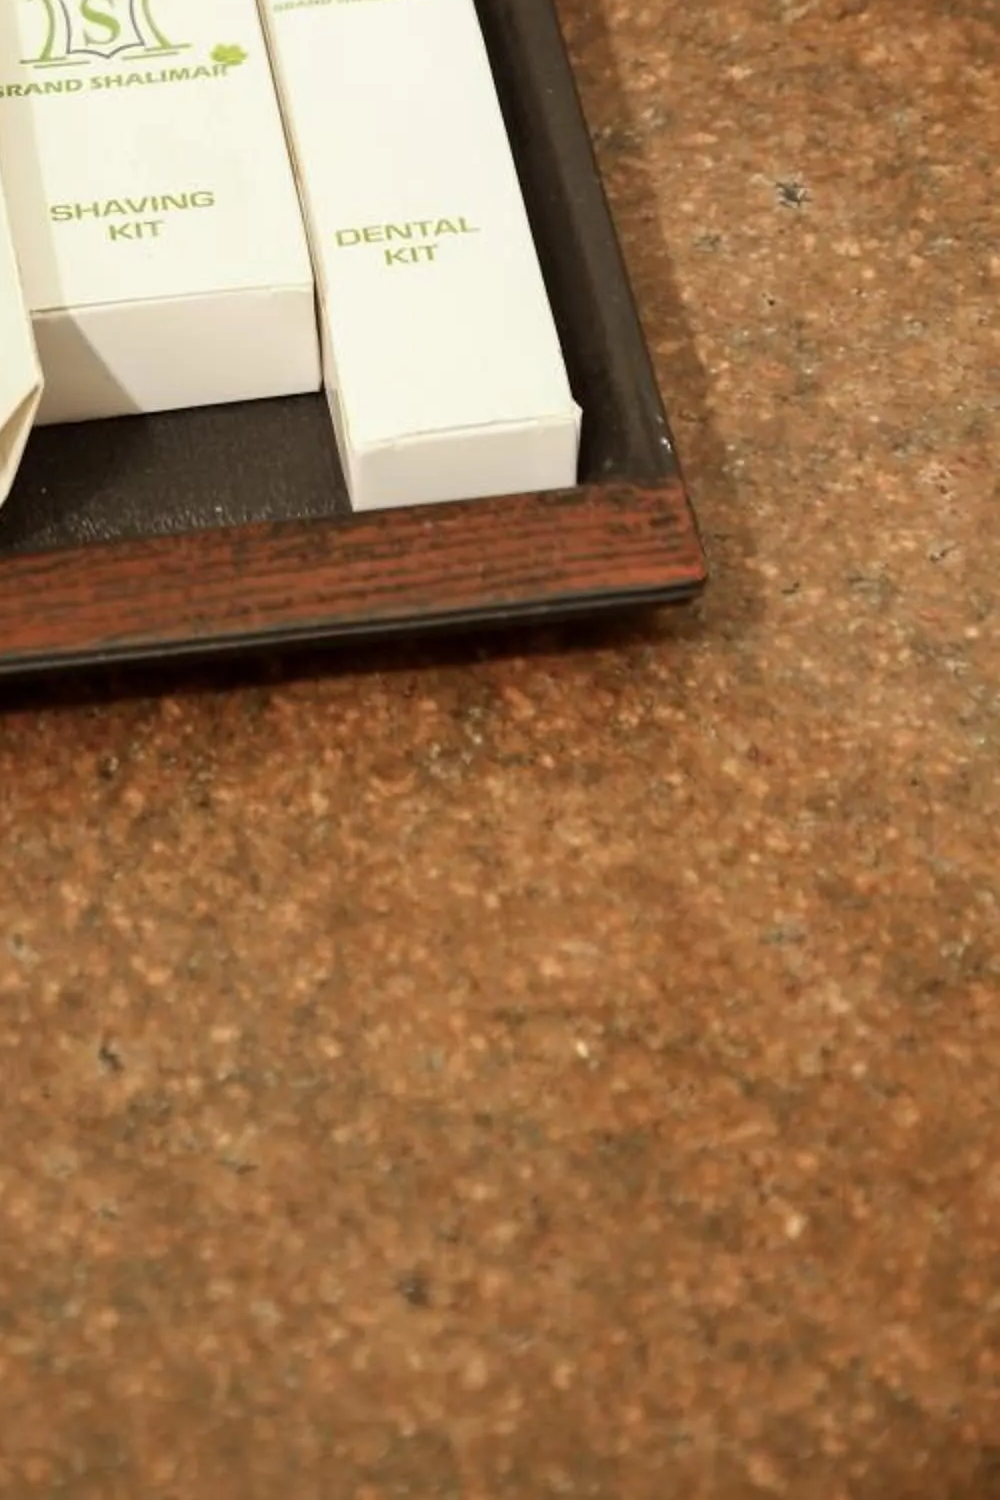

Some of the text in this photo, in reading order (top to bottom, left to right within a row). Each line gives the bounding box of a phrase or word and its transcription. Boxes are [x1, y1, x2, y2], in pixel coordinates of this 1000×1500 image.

[90, 63, 229, 91] SHALIMAR
[50, 190, 215, 221] SHAVING
[109, 220, 164, 241] KIT
[335, 216, 480, 247] DENTAL
[384, 244, 438, 266] KIT
